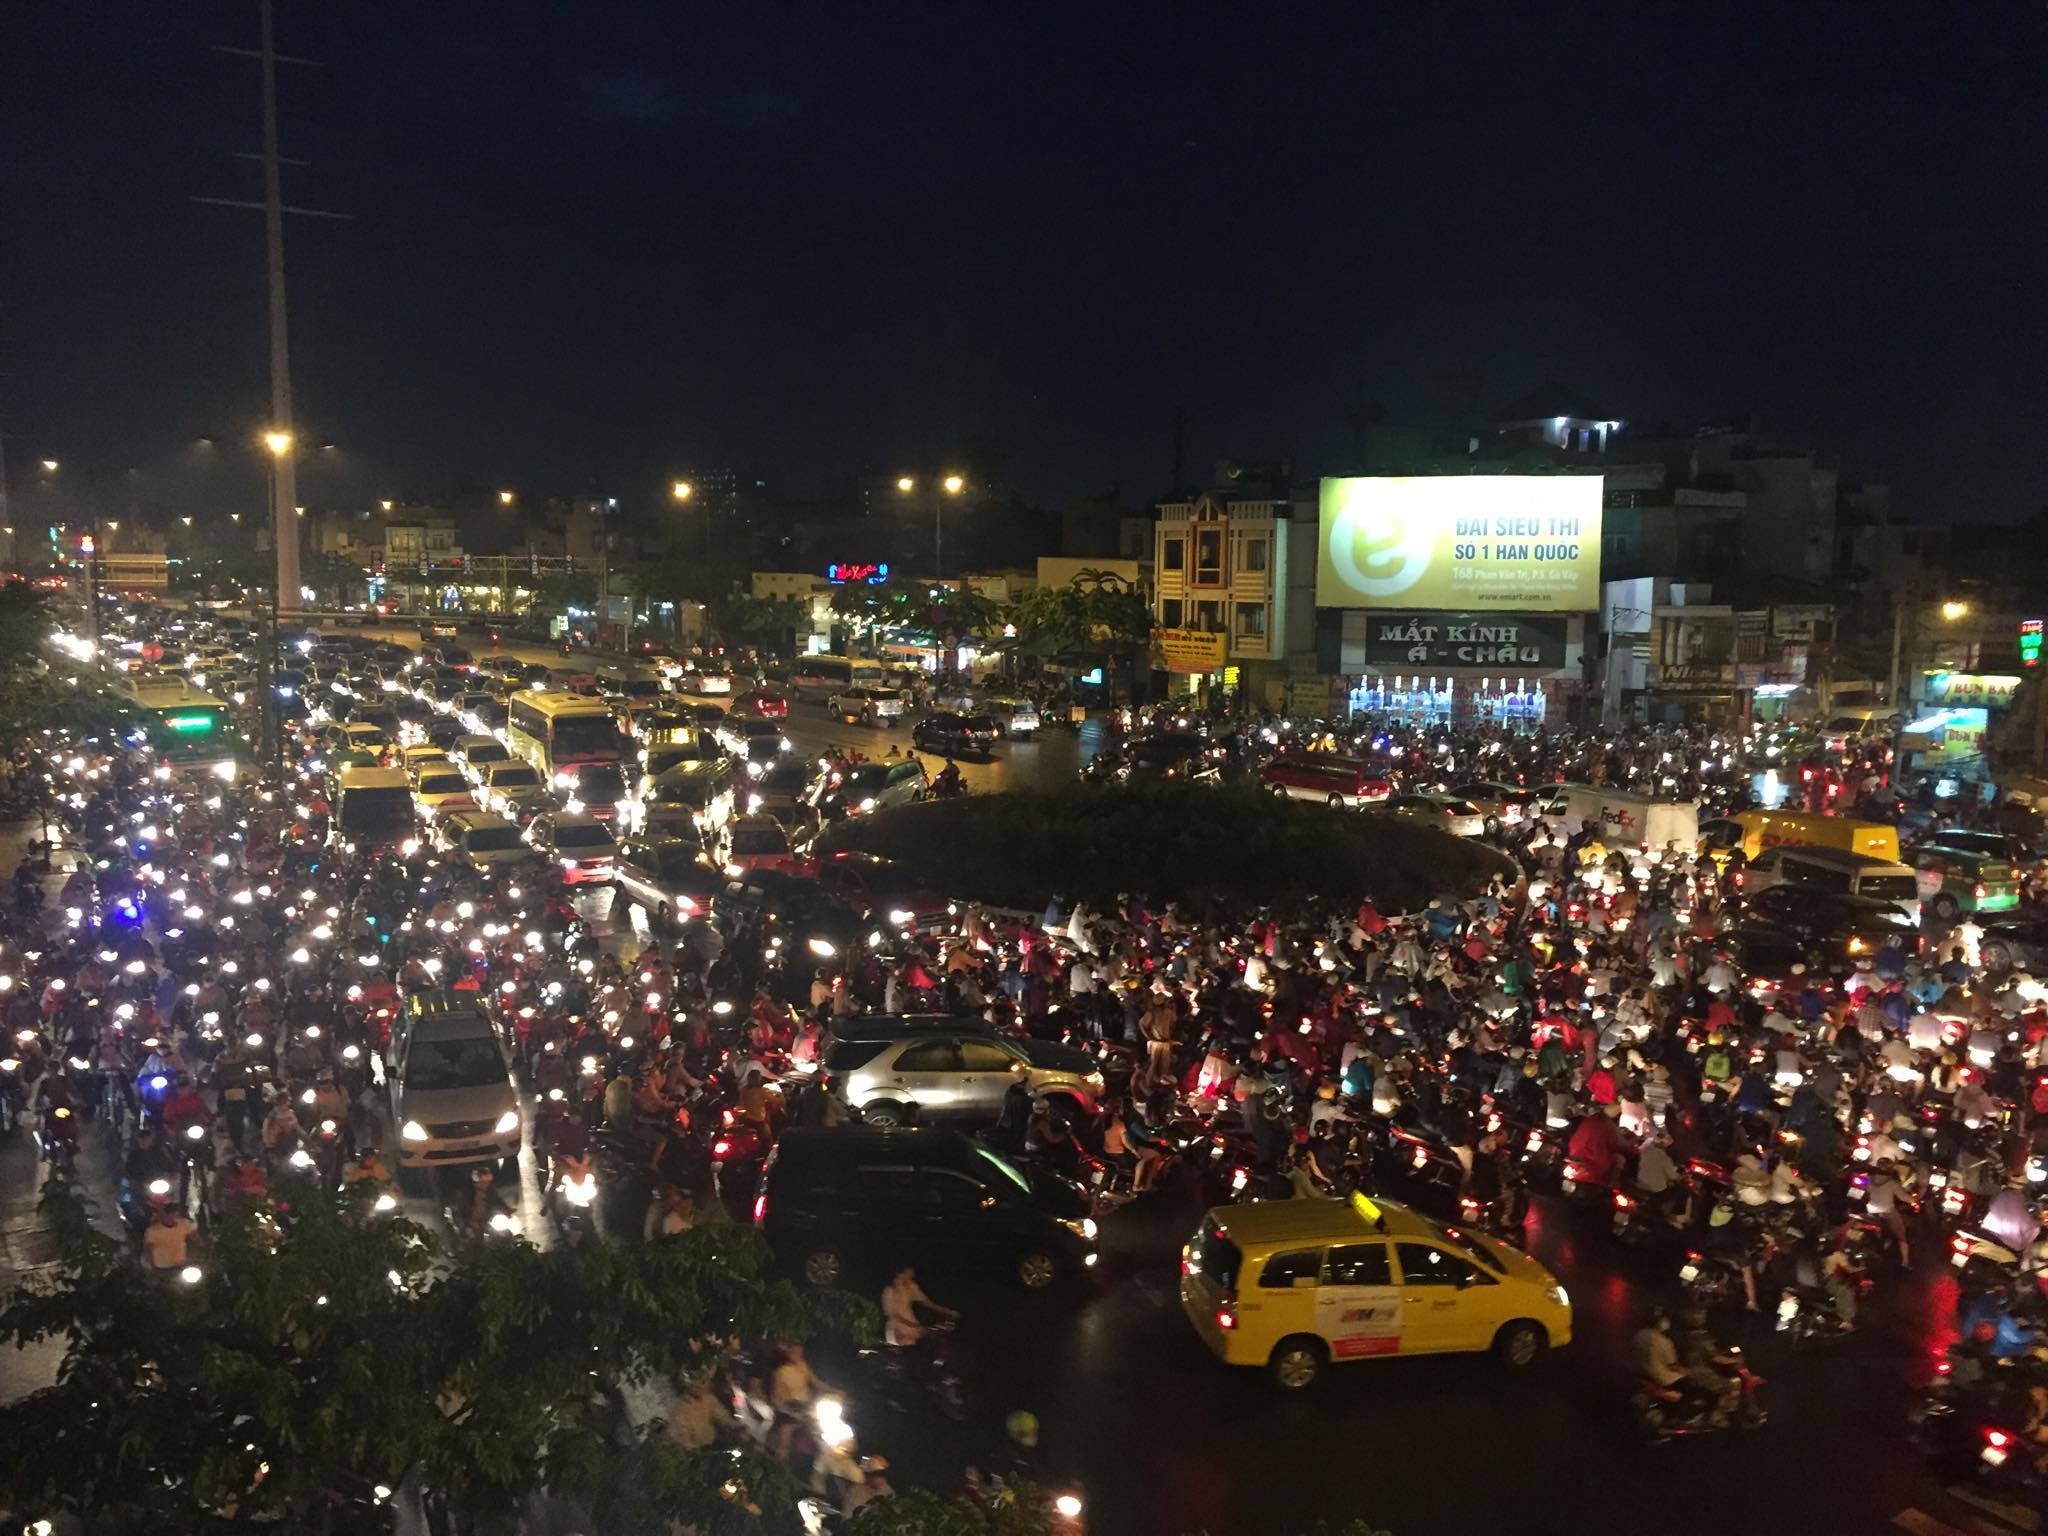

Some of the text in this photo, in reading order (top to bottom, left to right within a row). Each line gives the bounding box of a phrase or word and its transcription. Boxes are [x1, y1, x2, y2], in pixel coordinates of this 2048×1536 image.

[1482, 544, 1489, 560] 1
[1447, 621, 1519, 643] KÍNH
[1600, 806, 1637, 829] FedEx
